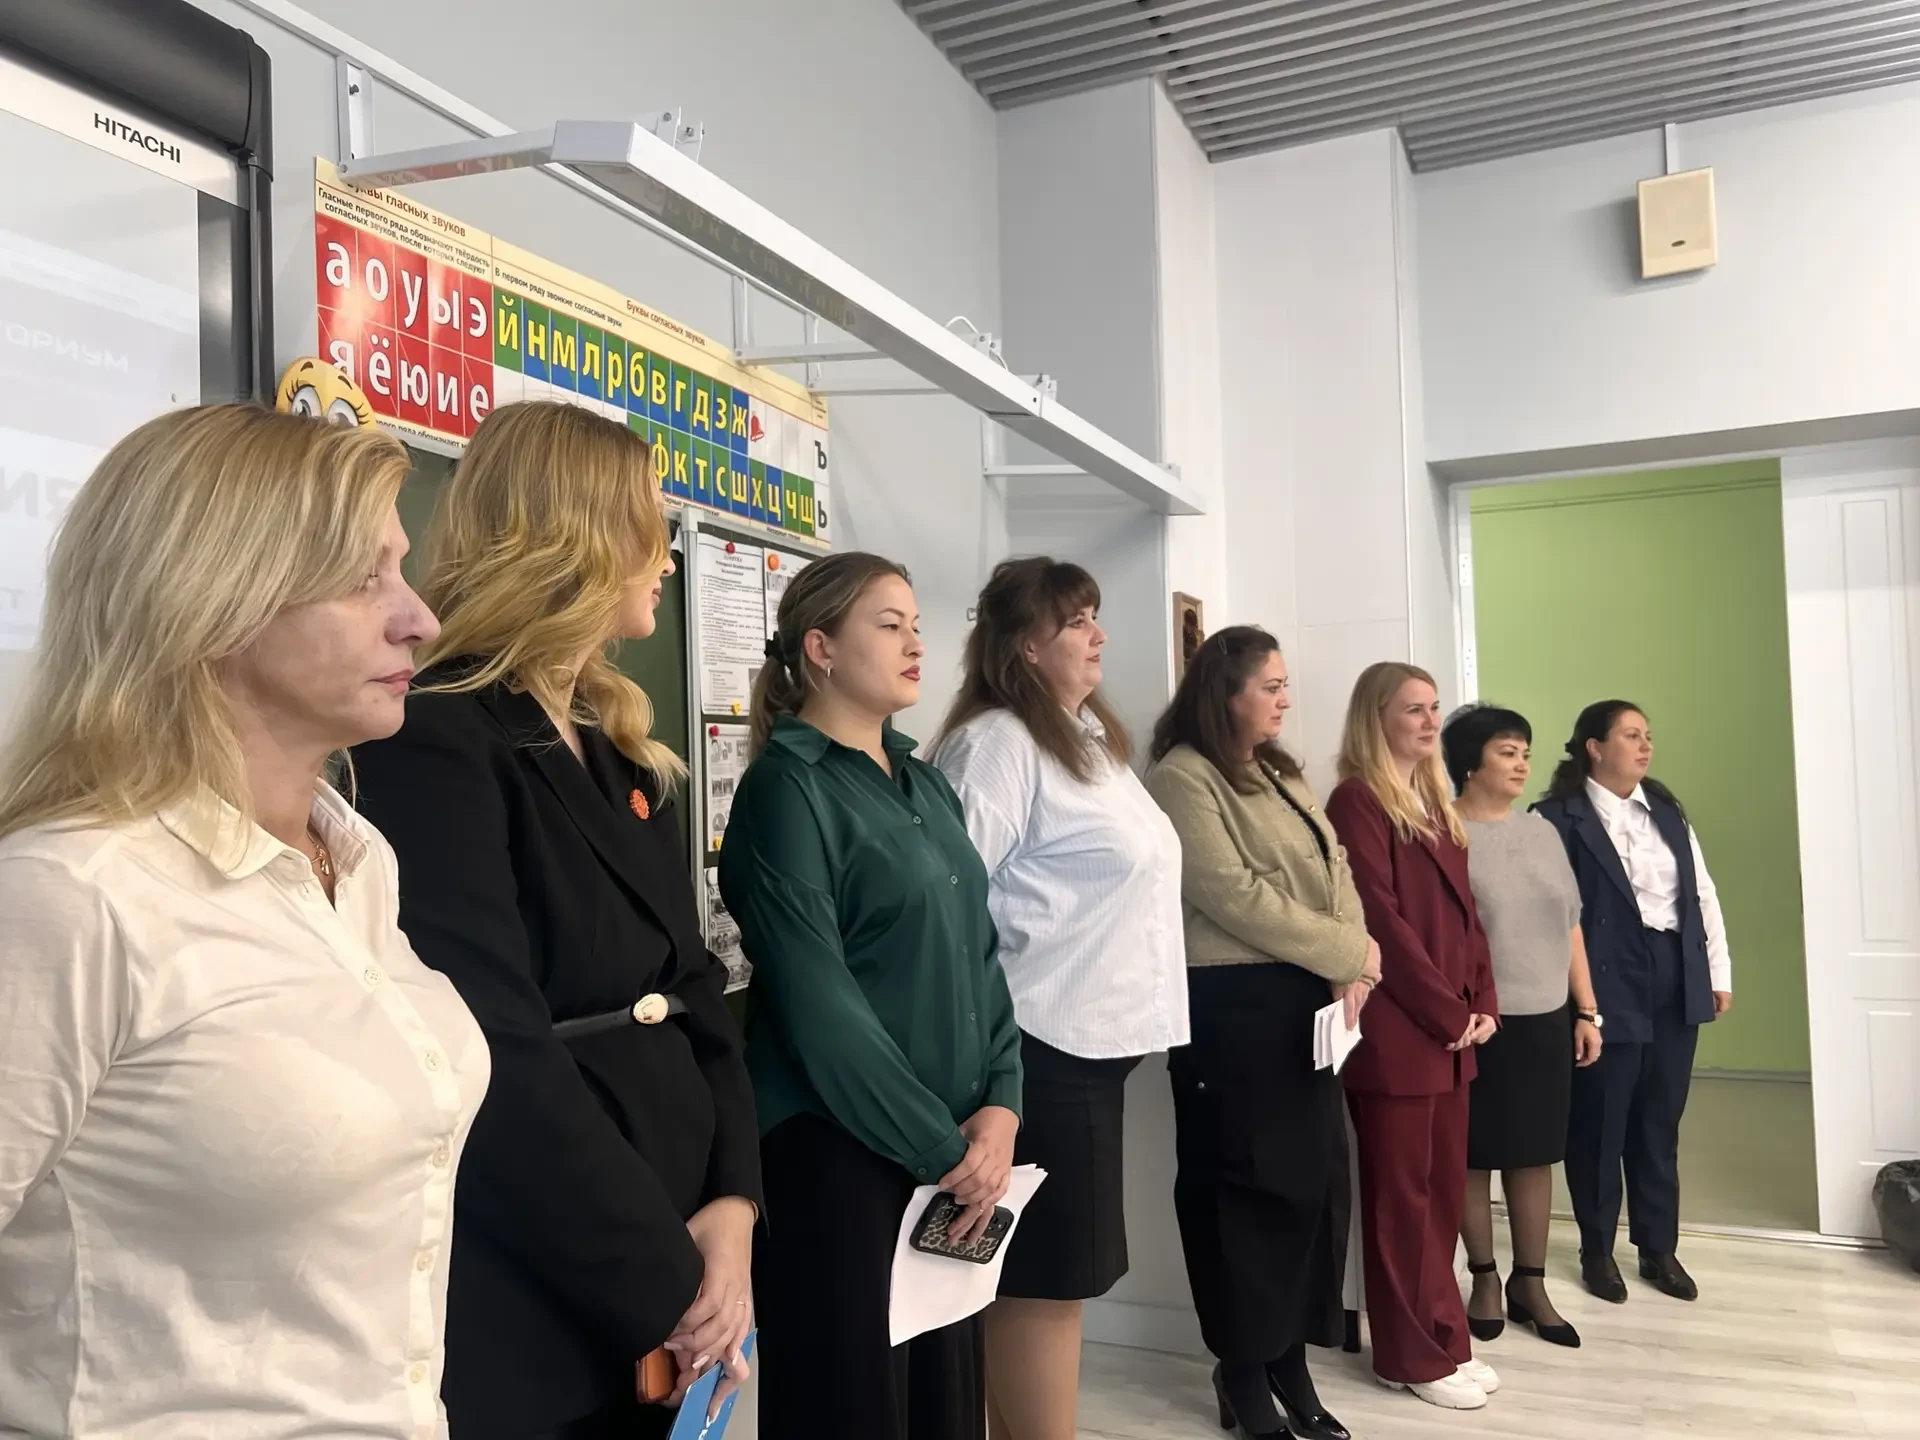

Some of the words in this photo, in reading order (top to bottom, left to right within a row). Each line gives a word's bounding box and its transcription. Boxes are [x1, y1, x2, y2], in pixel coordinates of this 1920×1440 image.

[93, 112, 182, 164] HITACHI
[318, 187, 354, 210] Гласные
[355, 205, 389, 225] первого
[390, 219, 409, 233] ряда
[410, 228, 454, 252] обозначают
[455, 247, 490, 268] твёрдость
[324, 202, 369, 226] согласных
[400, 234, 422, 249] после
[423, 244, 455, 263] которых
[456, 258, 486, 275] следуют
[386, 195, 429, 221] гласных
[431, 214, 467, 237] звуков
[325, 241, 350, 290] а
[364, 257, 389, 303] о
[400, 269, 423, 329] у
[431, 284, 461, 331] ы
[468, 296, 488, 338] э
[494, 266, 501, 277] В
[501, 272, 529, 289] первом
[529, 283, 546, 297] ряду
[546, 291, 573, 308] звонкие
[574, 301, 606, 321] согласные
[626, 299, 650, 319] Буквы
[650, 313, 684, 336] согласных
[684, 330, 706, 346] звуков
[368, 333, 392, 396] ё
[400, 359, 430, 407] ю
[437, 371, 459, 417] и
[497, 295, 518, 351] й
[527, 319, 546, 361] н
[552, 329, 577, 372] м
[582, 341, 601, 380] л
[607, 350, 624, 399] р
[629, 351, 646, 398] б
[651, 369, 667, 405] в
[675, 379, 687, 413] г
[693, 388, 709, 432] д
[715, 397, 728, 429] з
[732, 403, 748, 439] ж
[673, 450, 689, 485] к
[695, 457, 708, 490] т
[715, 466, 727, 497] с
[731, 470, 748, 504] ш
[751, 477, 763, 509] х
[768, 483, 782, 522] ц
[785, 489, 797, 520] ч
[800, 494, 815, 531] щ
